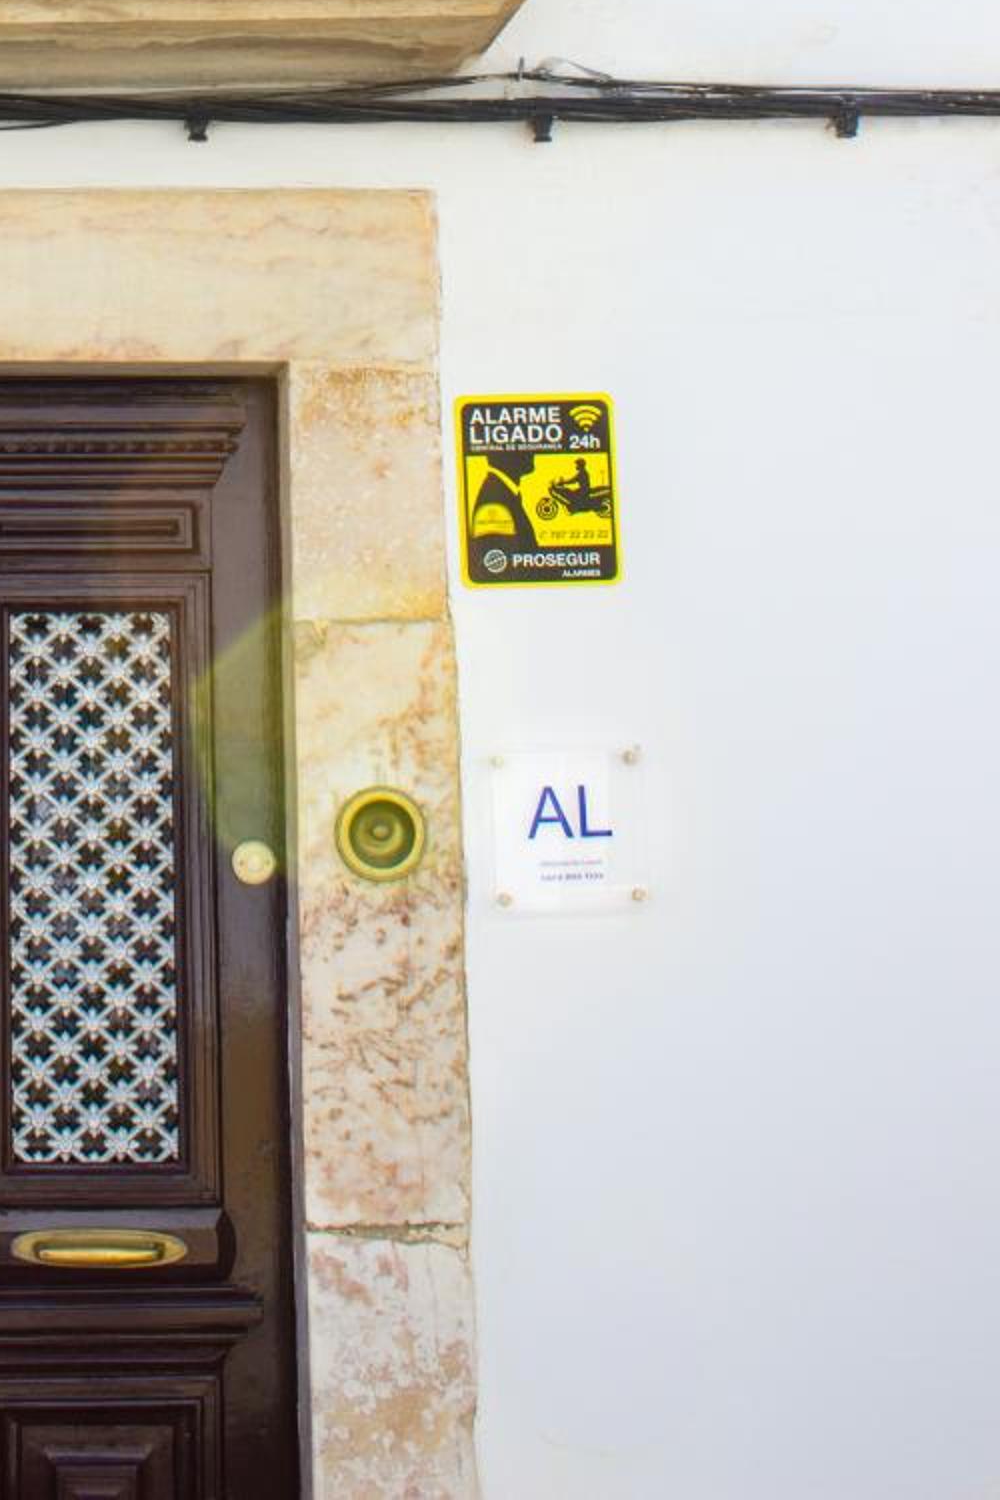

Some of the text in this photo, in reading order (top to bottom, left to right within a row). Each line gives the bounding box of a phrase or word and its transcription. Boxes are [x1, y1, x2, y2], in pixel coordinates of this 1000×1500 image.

[469, 406, 562, 425] ALARME
[469, 424, 563, 444] LIGADO
[569, 434, 601, 449] 24h
[511, 552, 601, 567] PROSEGUR
[528, 784, 613, 839] AL
